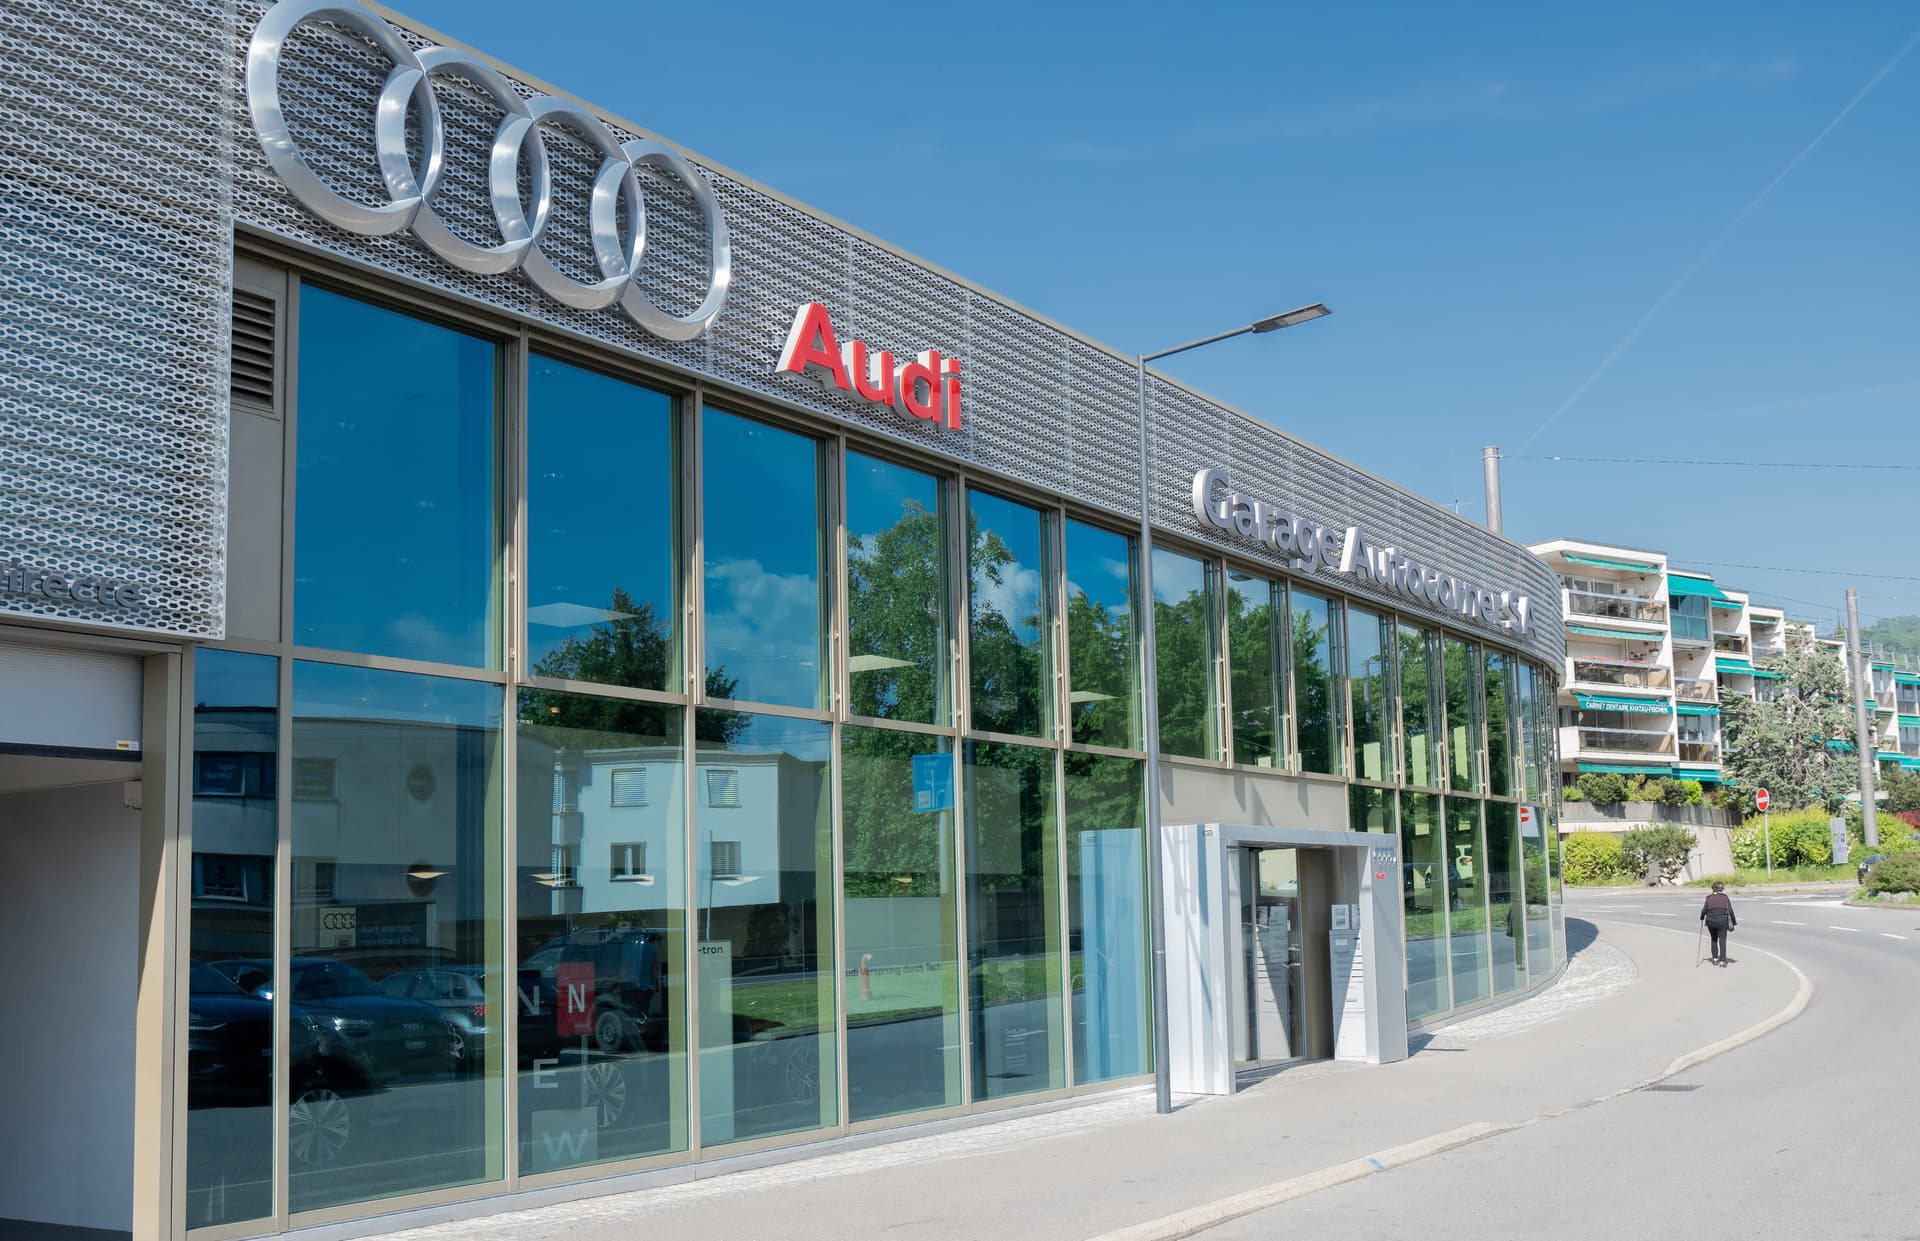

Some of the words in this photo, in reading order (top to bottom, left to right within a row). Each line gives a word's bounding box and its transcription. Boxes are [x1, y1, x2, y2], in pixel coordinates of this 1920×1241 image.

[775, 301, 962, 431] Audi
[1193, 468, 1340, 573] Garage
[1339, 527, 1503, 626] Autocorner
[1500, 591, 1537, 638] SA
[0, 560, 147, 608] irecte
[1586, 702, 1605, 710] CABINET
[1606, 703, 1629, 712] DENTAIRE
[568, 984, 585, 1014] N
